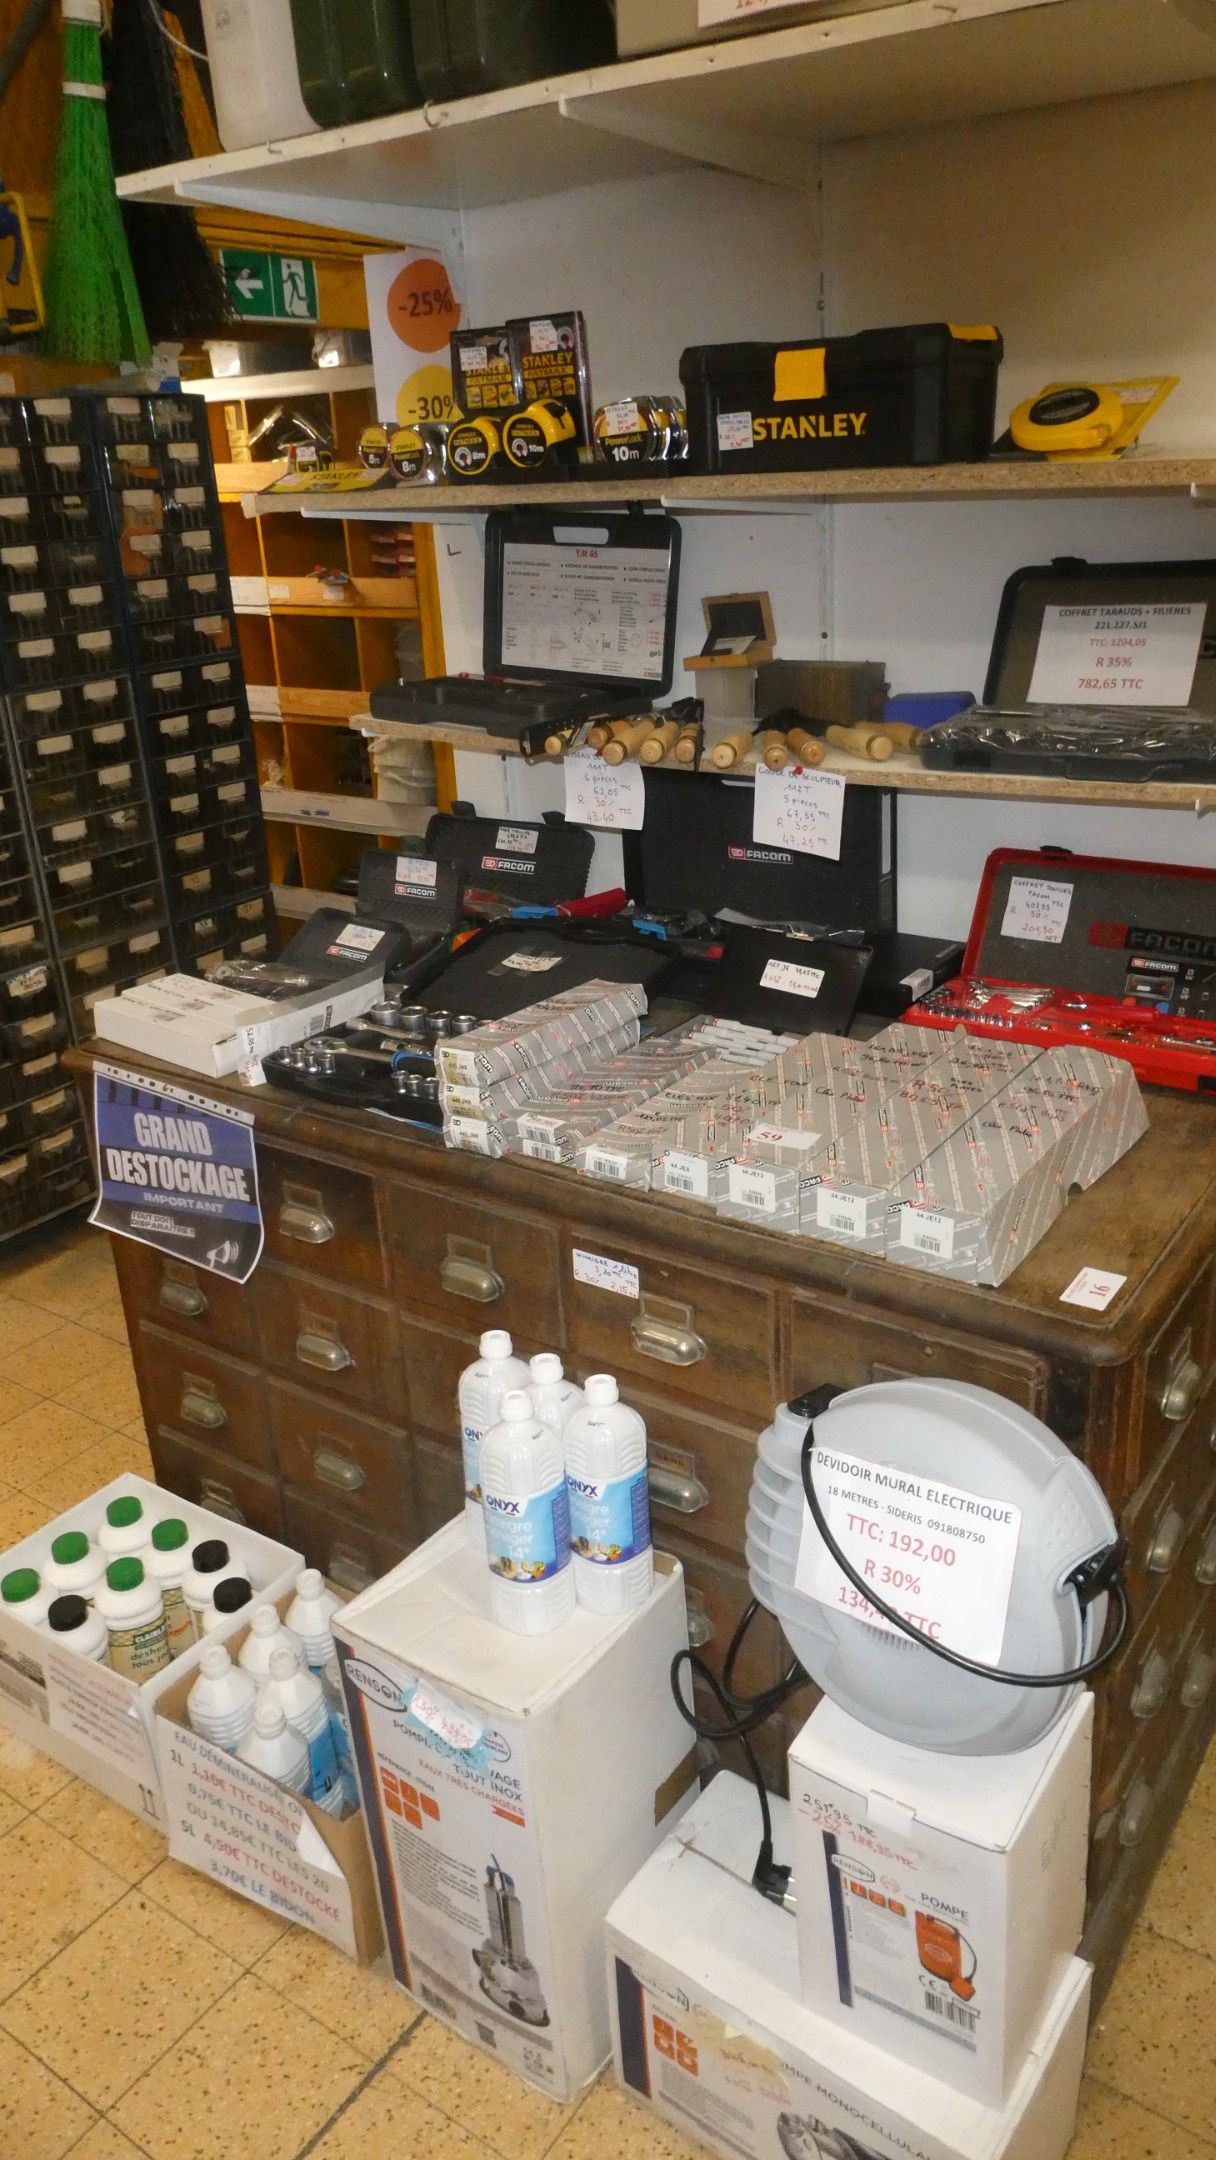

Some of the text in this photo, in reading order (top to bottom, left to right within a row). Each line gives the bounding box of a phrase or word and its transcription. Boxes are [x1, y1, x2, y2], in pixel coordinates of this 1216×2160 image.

[522, 351, 573, 368] STANLEY
[754, 412, 867, 441] STANLEY
[612, 446, 640, 462] 10m
[401, 461, 417, 473] 8m
[1058, 608, 1098, 617] COFFRET
[1099, 607, 1144, 617] TARAUDS
[1095, 657, 1132, 668] R 35%
[1077, 678, 1144, 690] 782,65 TTC
[497, 859, 536, 873] FACOM
[746, 850, 792, 863] FACOM
[406, 887, 436, 898] FACOM
[1144, 960, 1177, 971] FACOM
[133, 1112, 213, 1156] GRAND
[106, 1148, 250, 1201] DESTOCKAGE
[143, 1192, 225, 1214] IMPORTANT
[566, 1475, 599, 1498] ONYX
[816, 1451, 1013, 1525] DEVIDOIR MURAL ELECTRIQUE
[486, 1494, 520, 1514] ONYX
[827, 1484, 840, 1496] 18
[840, 1488, 880, 1510] METRES
[886, 1504, 923, 1526] SIDERIS
[927, 1518, 986, 1545] 091808750
[846, 1513, 957, 1567] TTC: 192,00
[863, 1558, 922, 1596] R 30%
[175, 1731, 197, 1752] EAU
[419, 1757, 444, 1777] EAUX
[229, 1783, 256, 1807] TTC
[490, 1781, 523, 1802] INOX
[228, 1803, 254, 1825] TTC
[242, 1851, 269, 1877] TTC
[250, 1879, 266, 1898] LE
[920, 1892, 969, 1920] POMPE
